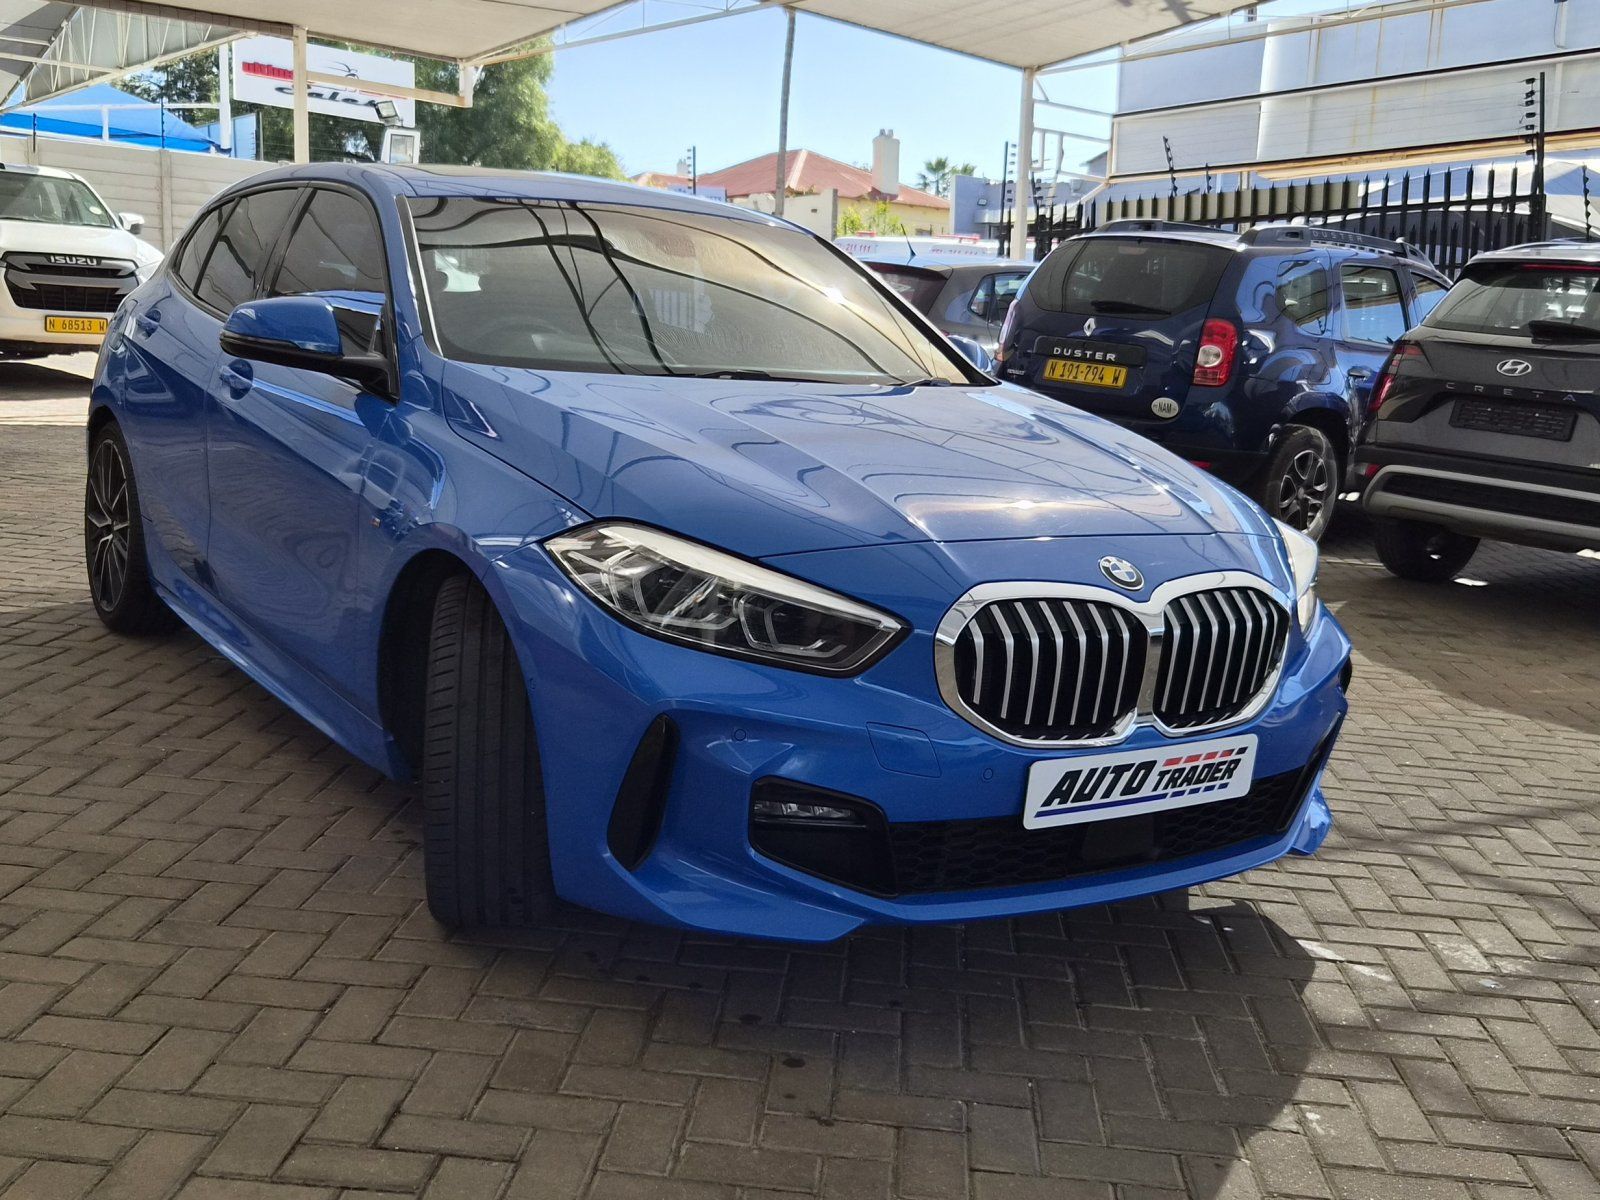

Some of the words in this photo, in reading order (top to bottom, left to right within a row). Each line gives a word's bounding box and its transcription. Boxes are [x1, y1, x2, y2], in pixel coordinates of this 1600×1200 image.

[1312, 231, 1363, 243] DUSTER
[50, 255, 97, 266] ISUZU
[48, 319, 55, 329] N
[62, 319, 92, 331] 68513
[99, 321, 105, 332] W
[1053, 347, 1116, 362] DUSTER
[1049, 361, 1056, 376] N
[1112, 369, 1120, 385] W
[1446, 382, 1576, 402] CRETA
[1157, 401, 1172, 414] NAM
[1040, 760, 1157, 808] AUTO
[1151, 758, 1242, 792] TRADER
